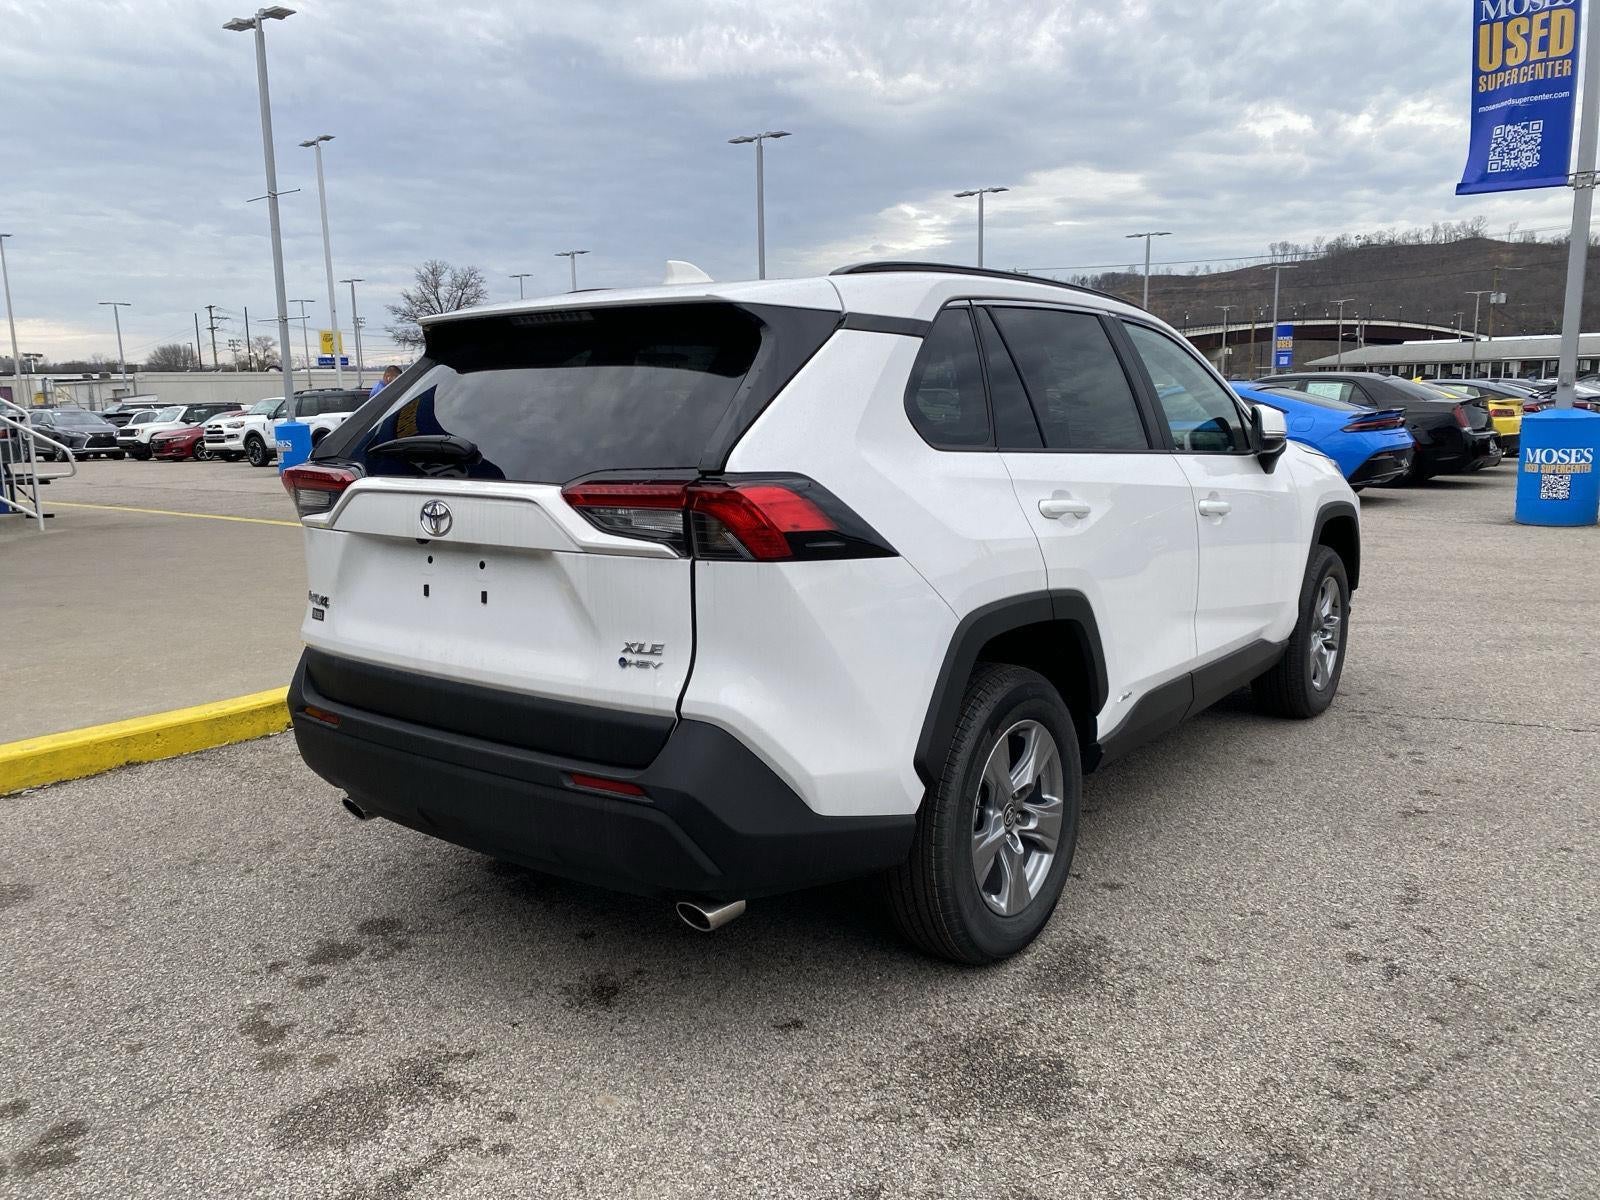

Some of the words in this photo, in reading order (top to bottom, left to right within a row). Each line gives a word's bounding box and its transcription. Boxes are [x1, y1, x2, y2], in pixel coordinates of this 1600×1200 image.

[1480, 0, 1576, 22] MOS
[1478, 8, 1576, 73] USED
[1478, 59, 1572, 93] SUPERCENTER
[1525, 447, 1594, 465] MOSES
[621, 641, 665, 656] XLE
